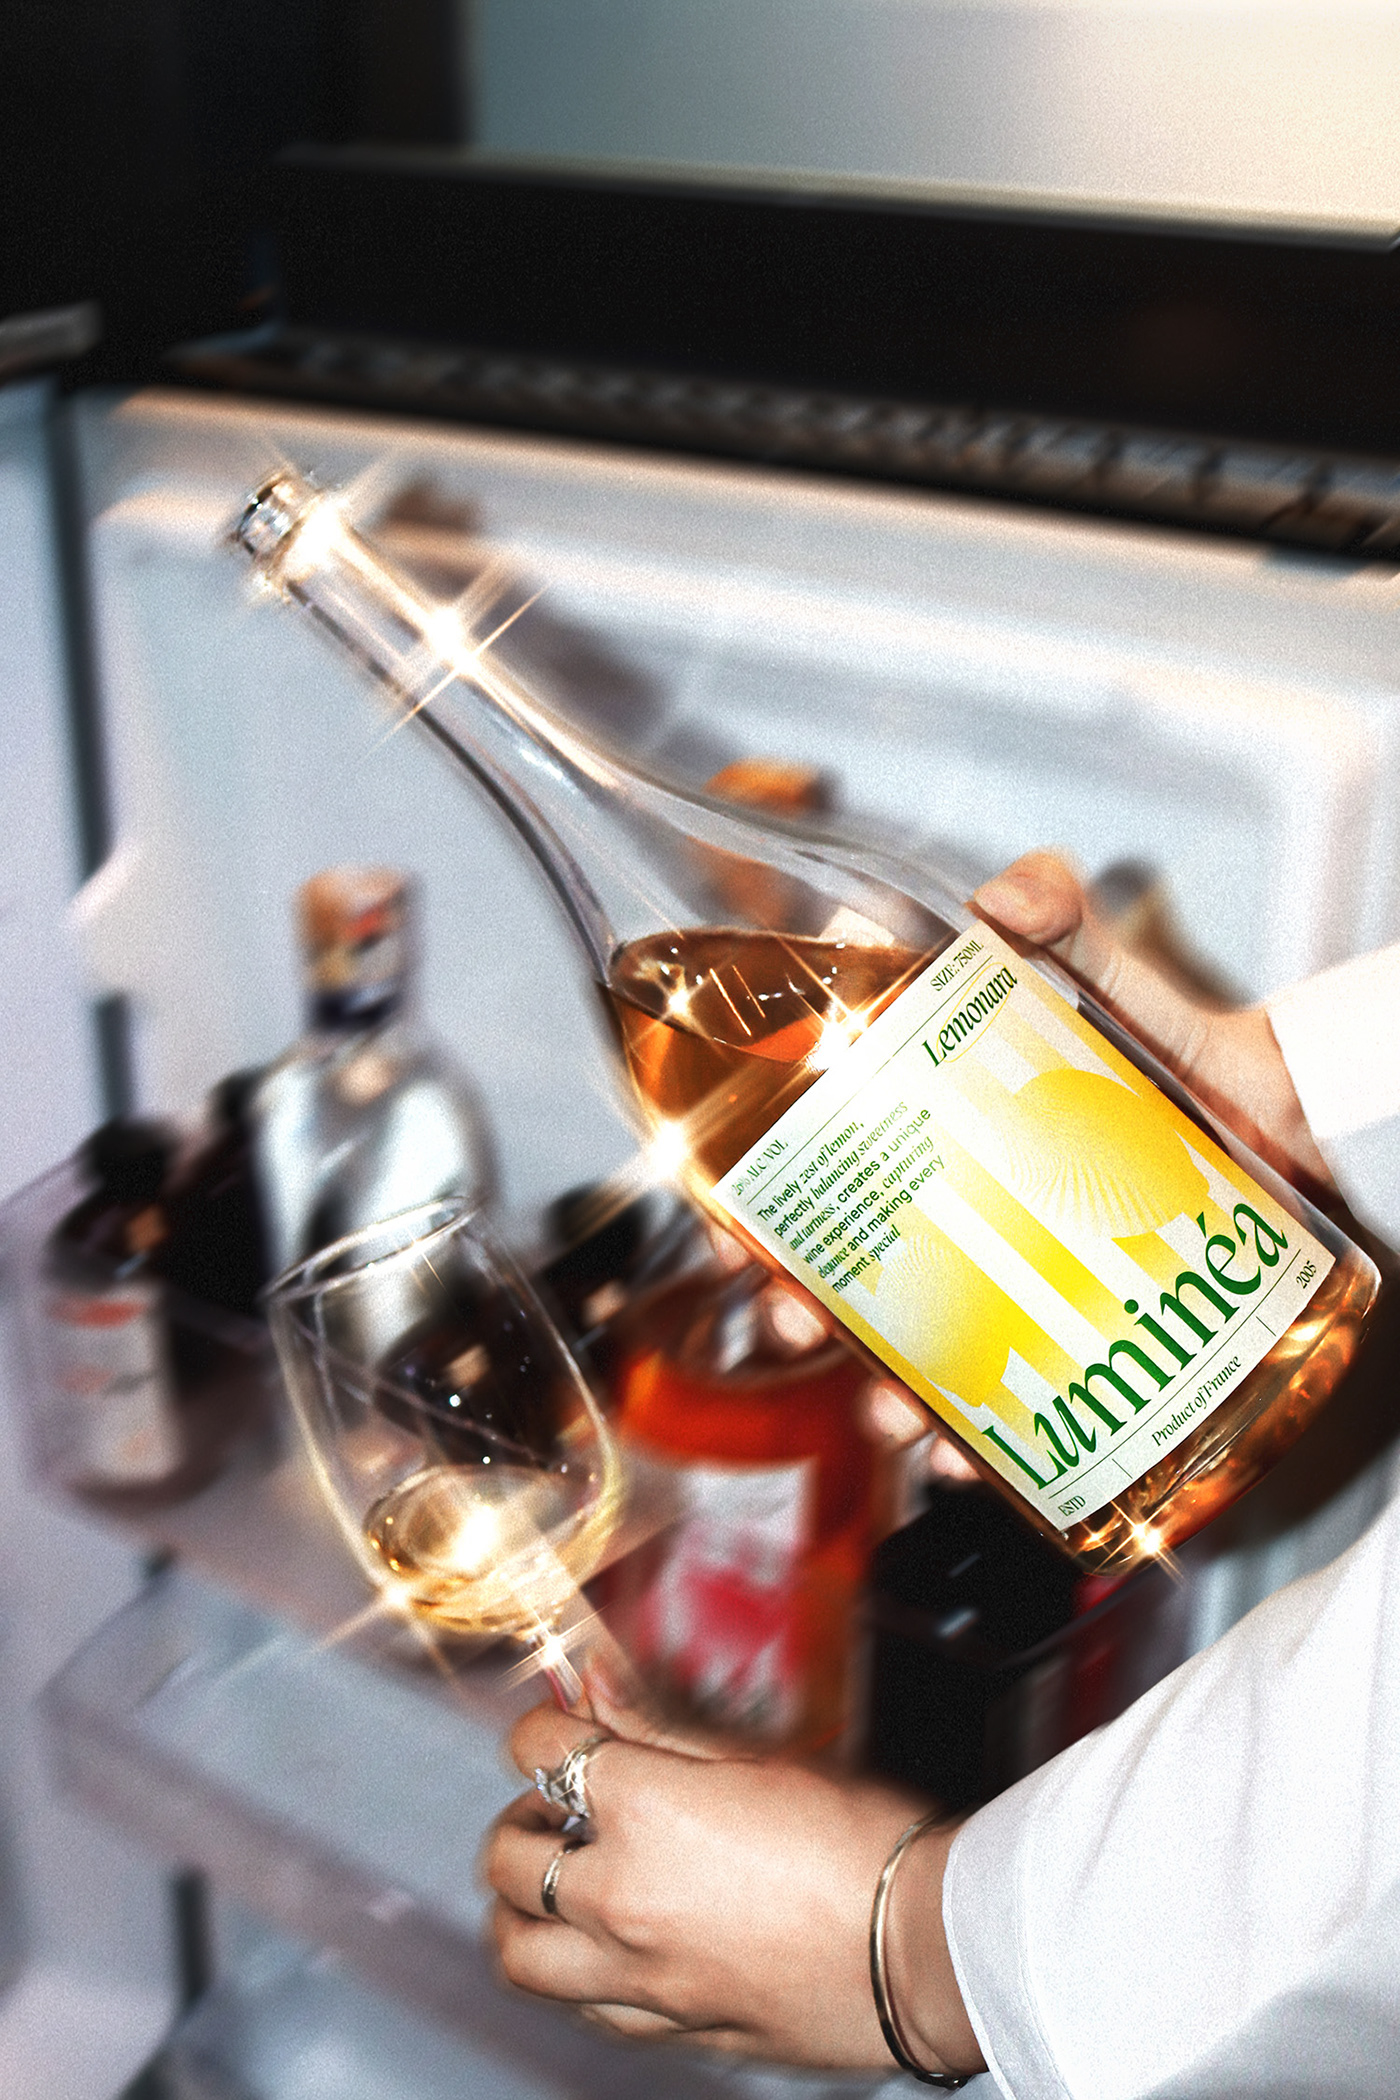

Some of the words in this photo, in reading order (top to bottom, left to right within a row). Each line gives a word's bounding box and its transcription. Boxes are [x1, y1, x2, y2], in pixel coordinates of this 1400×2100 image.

[930, 963, 960, 992] SIZE:
[953, 939, 985, 967] 750ML
[921, 966, 1019, 1067] Lemonara
[773, 1195, 815, 1239] perfectly
[810, 1150, 861, 1200] balancing
[857, 1100, 909, 1156] sweetness
[818, 1146, 831, 1167] of
[824, 1121, 864, 1157] lemon,
[771, 1179, 802, 1207] lively
[788, 1229, 805, 1251] and
[801, 1203, 840, 1239] tartness,
[837, 1160, 881, 1202] creates
[879, 1150, 890, 1162] a
[888, 1108, 932, 1152] unique
[799, 1159, 820, 1184] zest
[802, 1241, 826, 1264] wine
[822, 1189, 885, 1246] experience,
[883, 1135, 935, 1189] capturing
[756, 1205, 778, 1221] The
[818, 1247, 850, 1279] elegance
[847, 1226, 870, 1251] and
[867, 1188, 912, 1232] making
[910, 1154, 945, 1191] every
[831, 1256, 870, 1293] moment
[868, 1223, 902, 1262] special
[1297, 1260, 1318, 1289] 2005
[981, 1201, 1289, 1489] Luminéa
[1151, 1399, 1198, 1447] Product
[1194, 1386, 1209, 1407] of
[1203, 1354, 1243, 1398] France
[1058, 1494, 1087, 1518] ESTD
